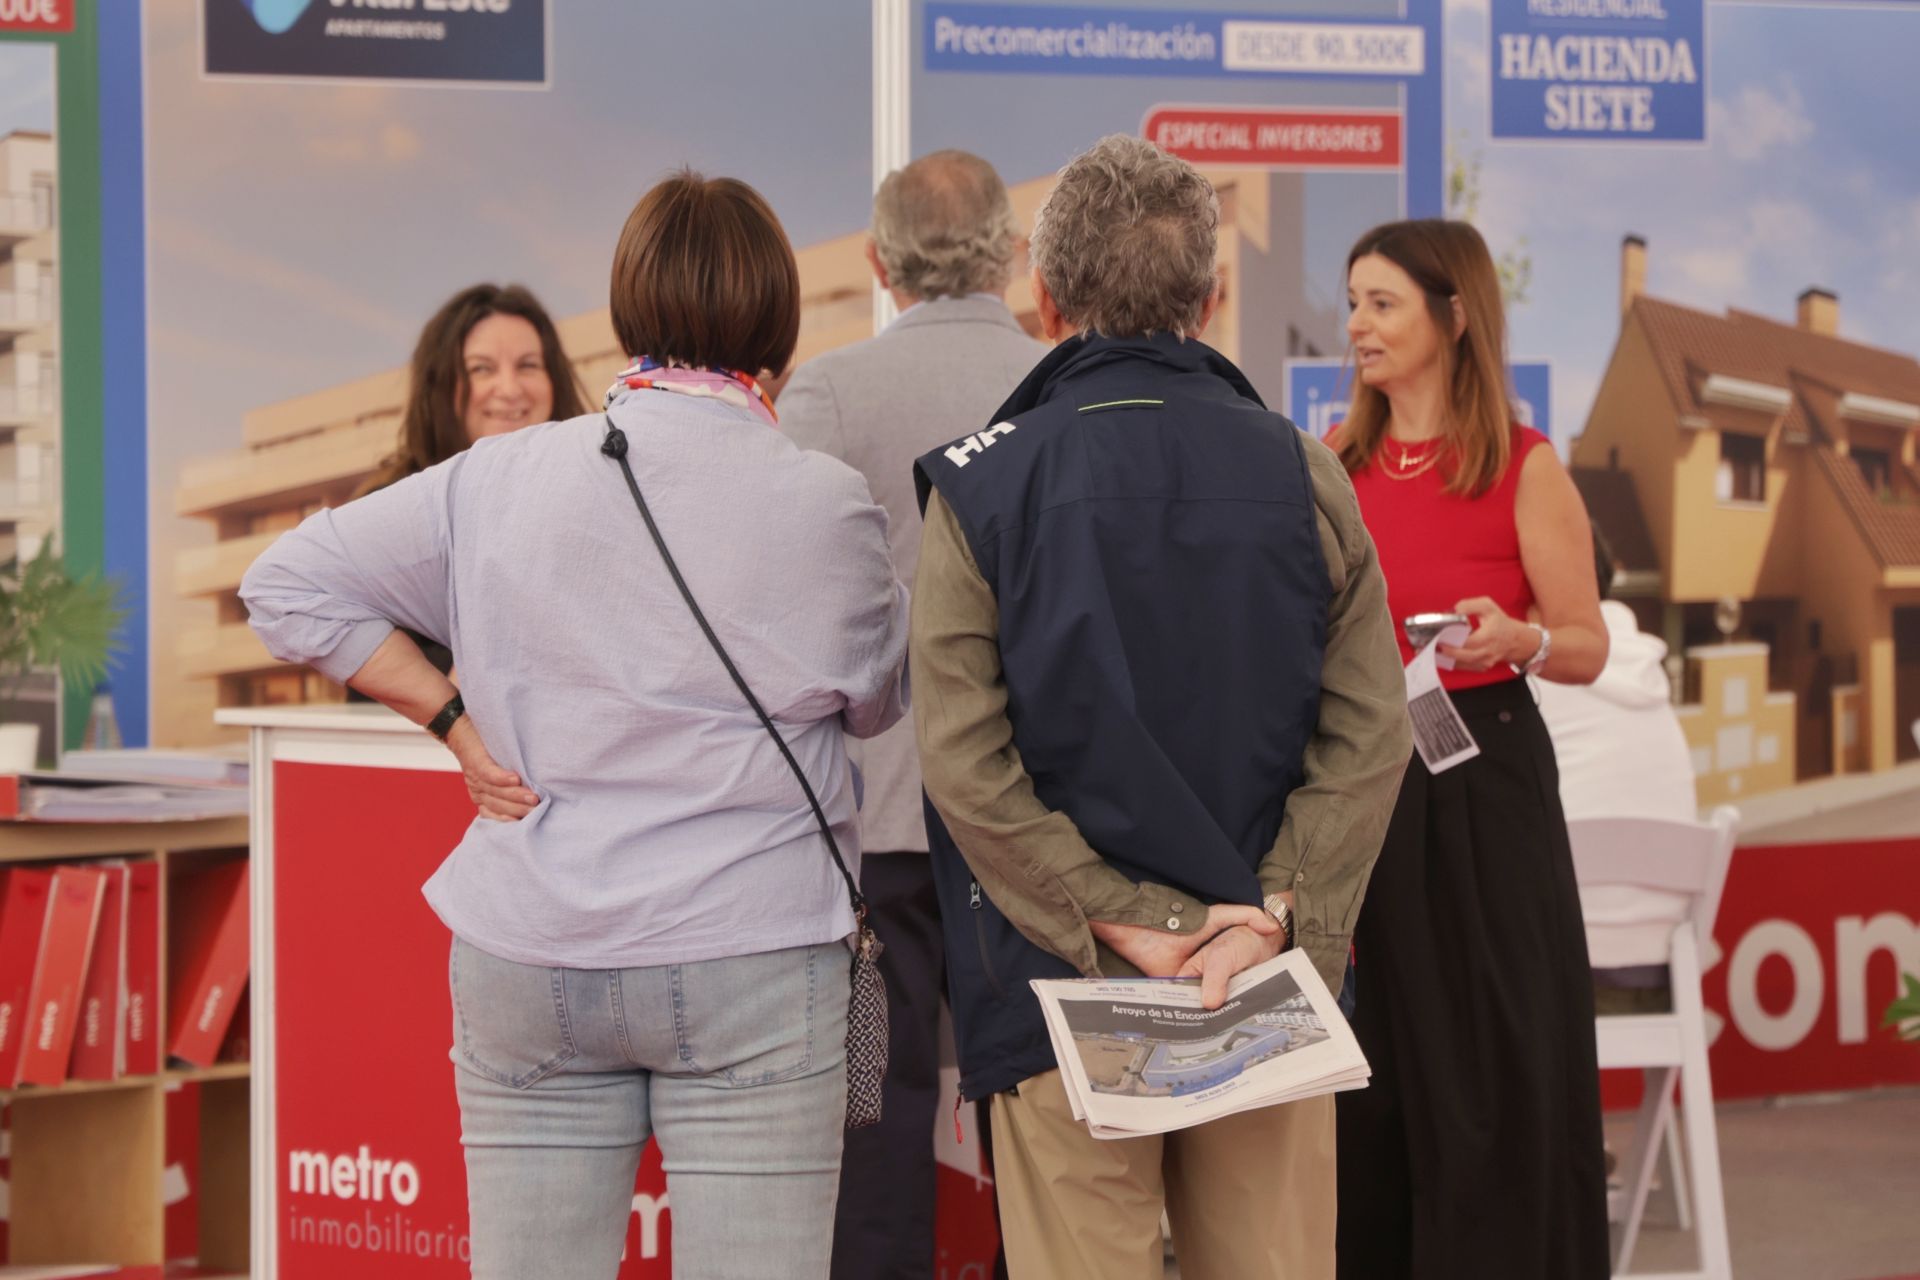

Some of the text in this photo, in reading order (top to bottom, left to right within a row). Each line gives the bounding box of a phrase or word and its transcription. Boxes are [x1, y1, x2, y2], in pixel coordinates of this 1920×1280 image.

[325, 18, 446, 40] APARTAMENTOS
[934, 16, 1216, 60] Precomercialización
[1236, 29, 1308, 62] DESDE
[1500, 33, 1697, 84] HACIENDA
[1544, 85, 1655, 132] SIETE
[1157, 121, 1384, 153] ESPECIAL INVERSORES
[1112, 1000, 1241, 1021] Arroyo de la Encomienda
[289, 1145, 420, 1207] metro
